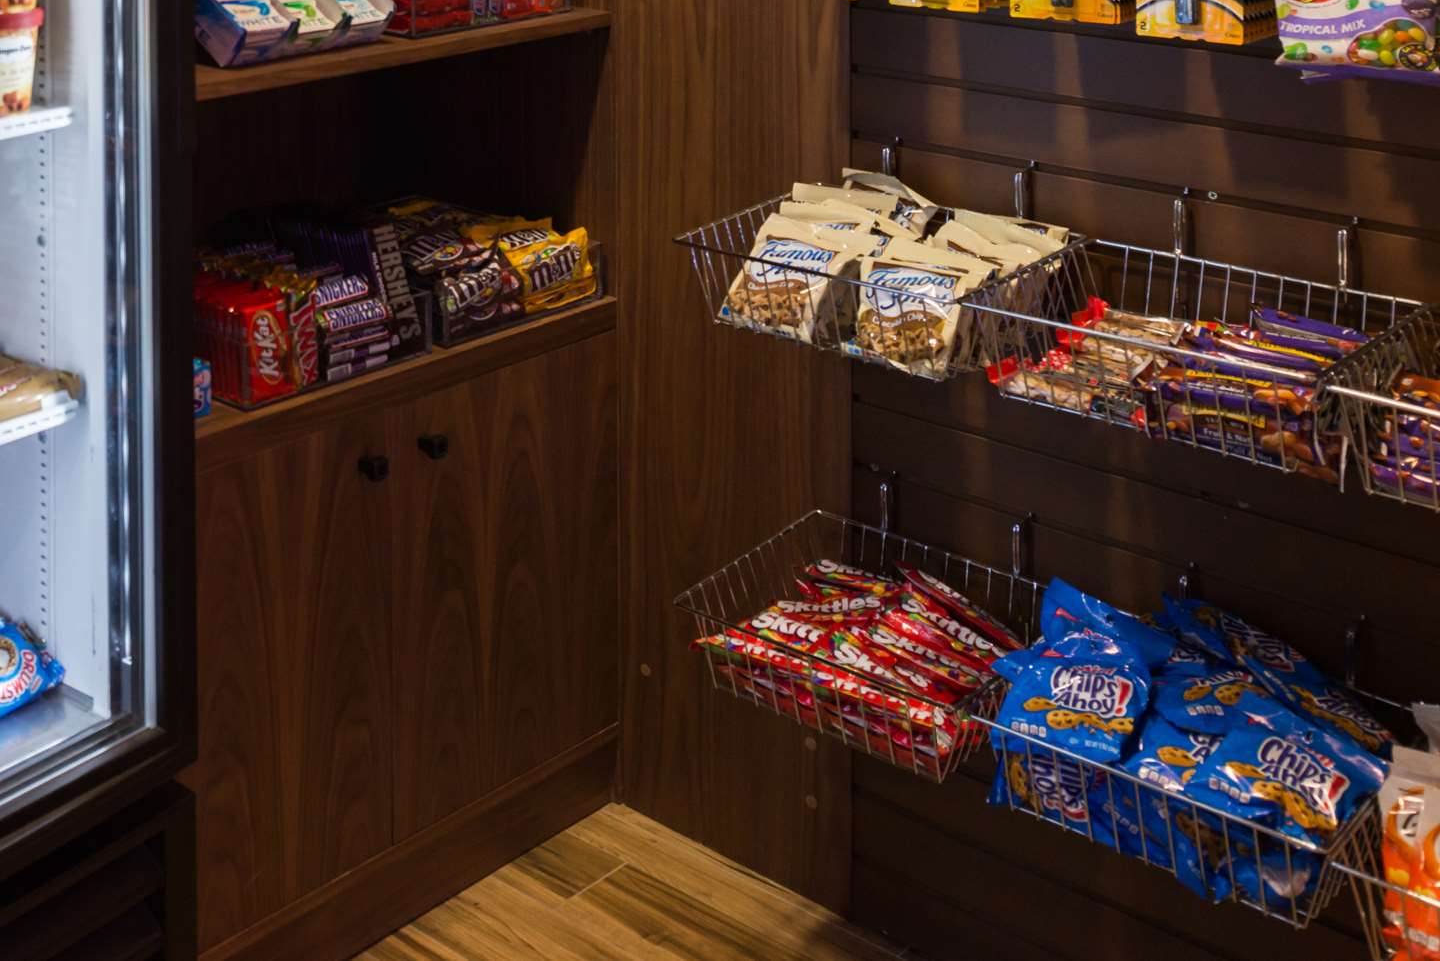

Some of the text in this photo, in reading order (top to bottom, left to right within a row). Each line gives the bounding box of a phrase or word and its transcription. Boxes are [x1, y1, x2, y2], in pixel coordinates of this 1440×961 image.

[1280, 19, 1366, 35] TROPICAL MIX
[760, 240, 835, 263] Famous
[372, 224, 423, 340] HERSHEY'S
[867, 268, 958, 291] Famous
[777, 596, 881, 615] Skittles
[1052, 666, 1119, 697] Chips
[1260, 739, 1327, 784] Chips
